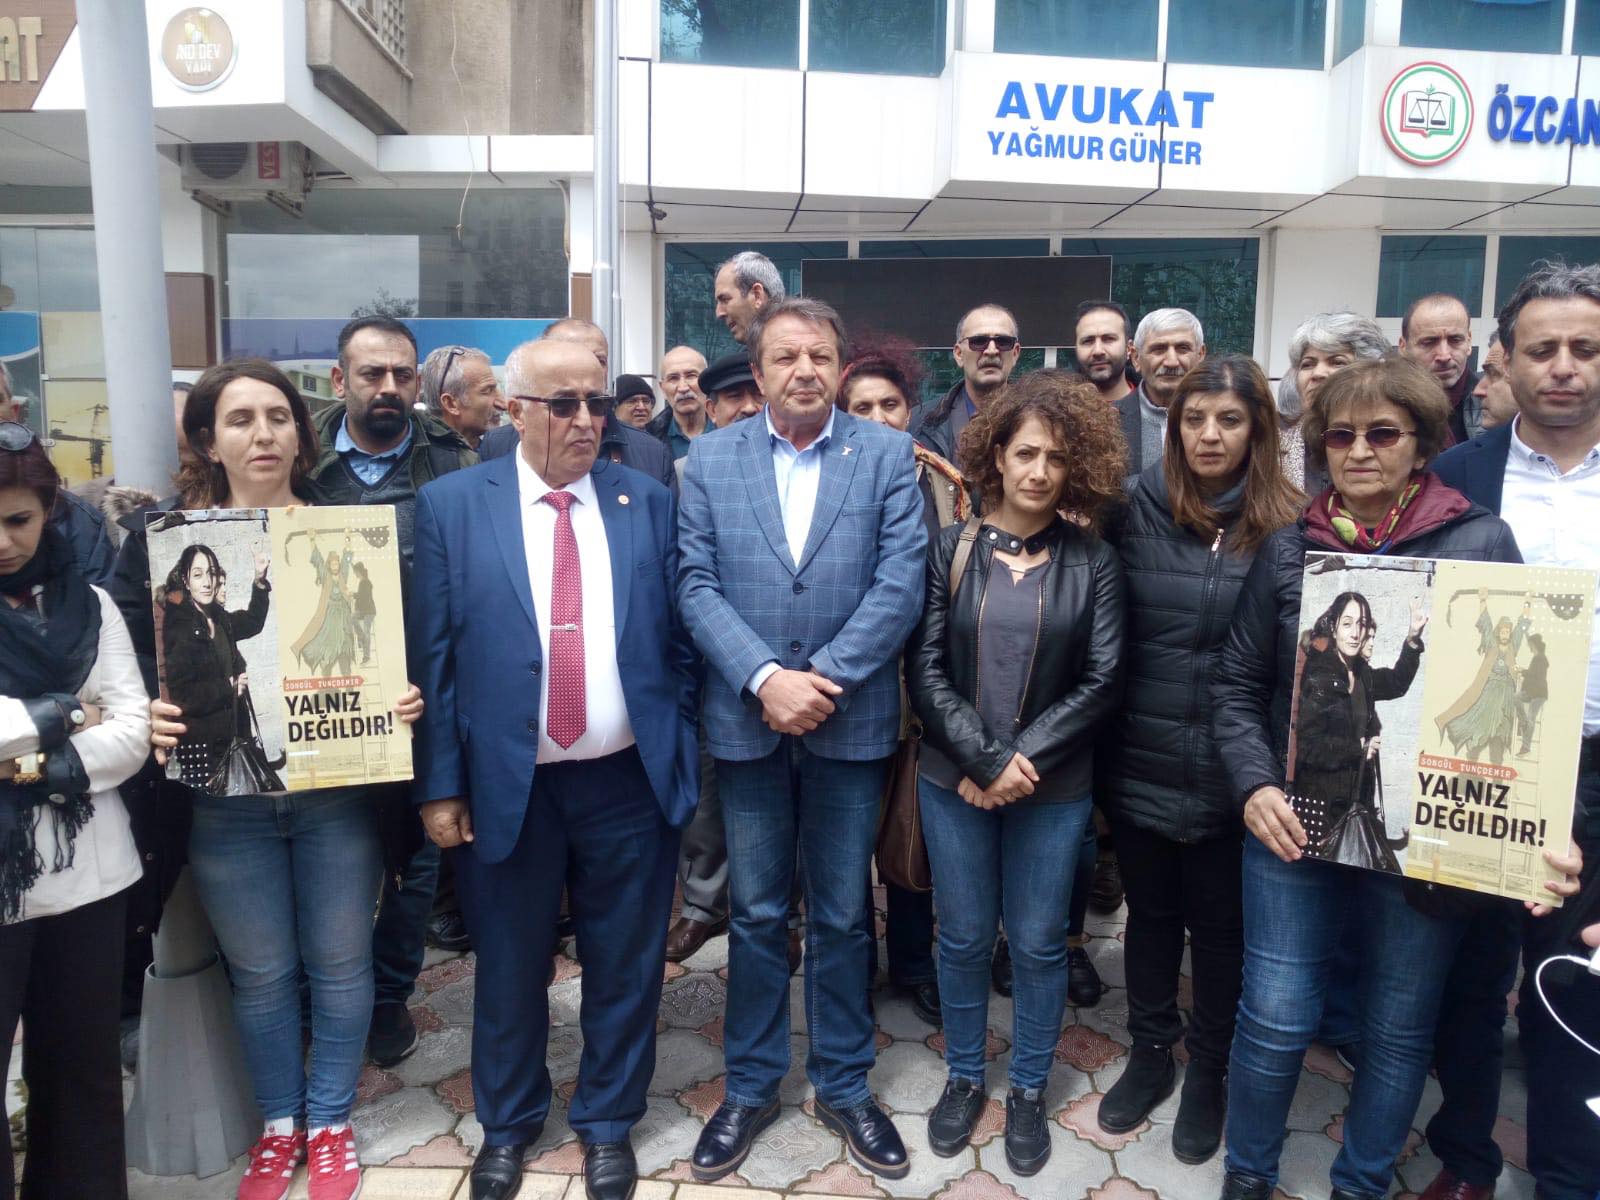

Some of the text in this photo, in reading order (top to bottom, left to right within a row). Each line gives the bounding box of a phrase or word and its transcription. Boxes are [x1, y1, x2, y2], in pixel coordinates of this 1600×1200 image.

[995, 81, 1214, 129] AVUKAT
[1487, 83, 1600, 146] ÖZCAN
[987, 126, 1202, 165] YAĞMUR GÜNER
[285, 691, 361, 716] YALNIZ
[288, 711, 393, 743] DEĞILDIR!
[1418, 771, 1511, 810] YALNIZ
[1415, 801, 1547, 848] DEĞILDIR!
